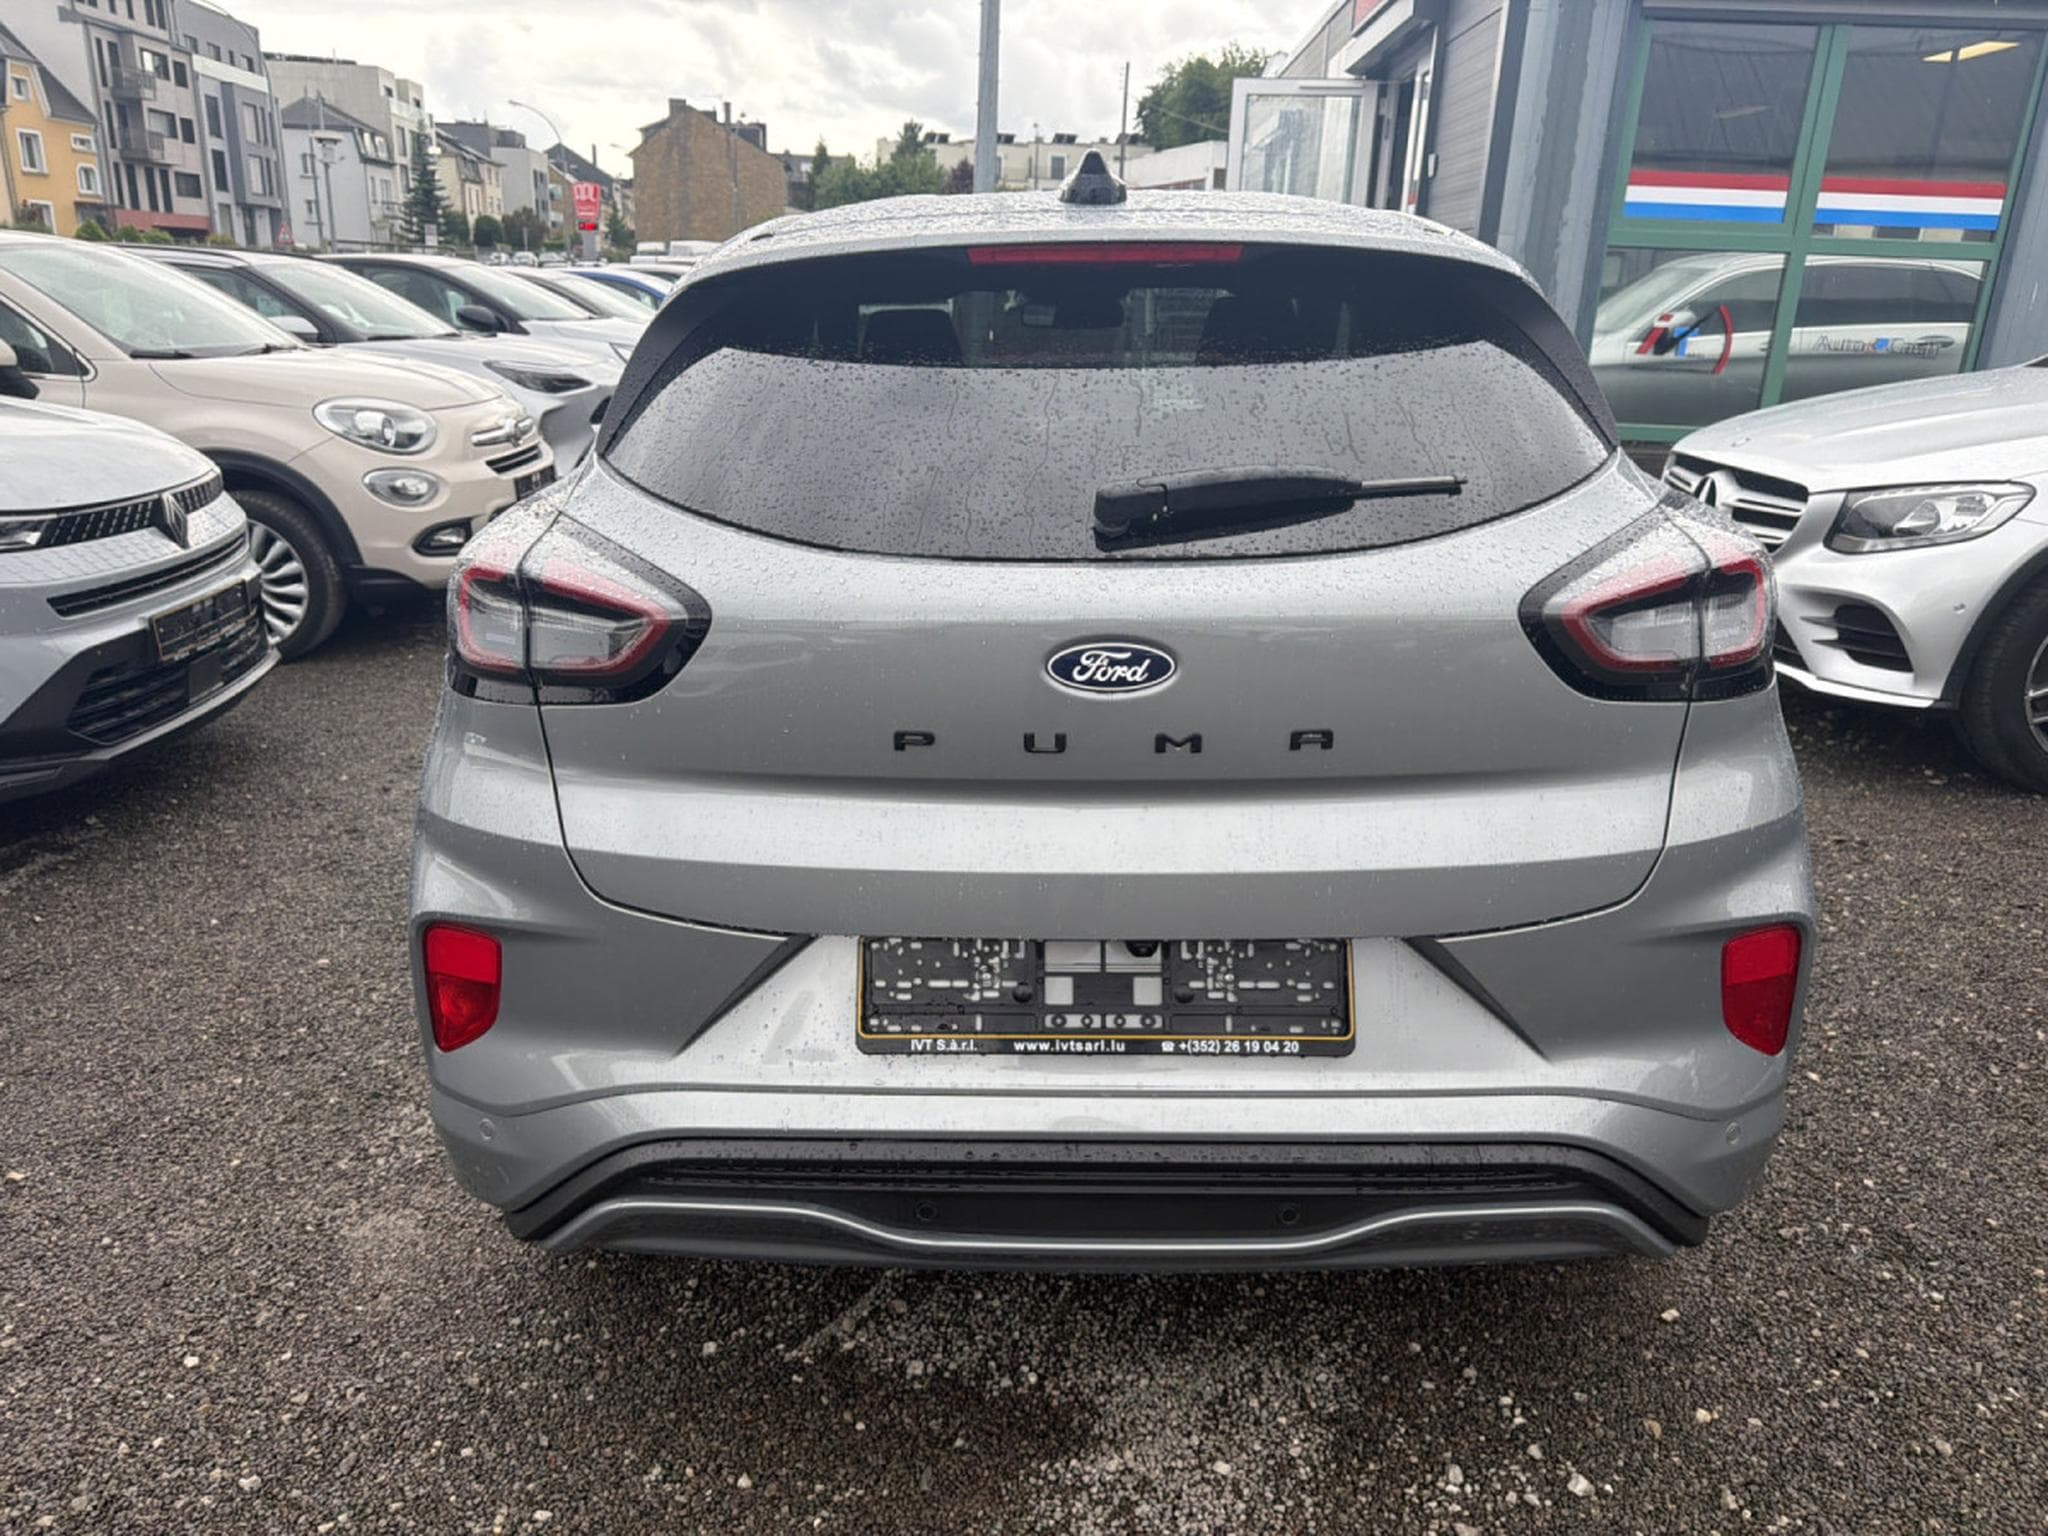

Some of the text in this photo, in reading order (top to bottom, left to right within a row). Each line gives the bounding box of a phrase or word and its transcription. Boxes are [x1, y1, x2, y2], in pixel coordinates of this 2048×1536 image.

[1072, 650, 1151, 684] Ford
[893, 729, 1334, 755] PUMA
[910, 1038, 933, 1052] IVT
[1013, 1039, 1126, 1053] www.ivtsarl.lu
[1178, 1038, 1221, 1054] +(352)
[1223, 1039, 1241, 1053] 26
[1244, 1039, 1261, 1053] 19
[1263, 1039, 1280, 1053] 04
[1282, 1039, 1300, 1053] 20
